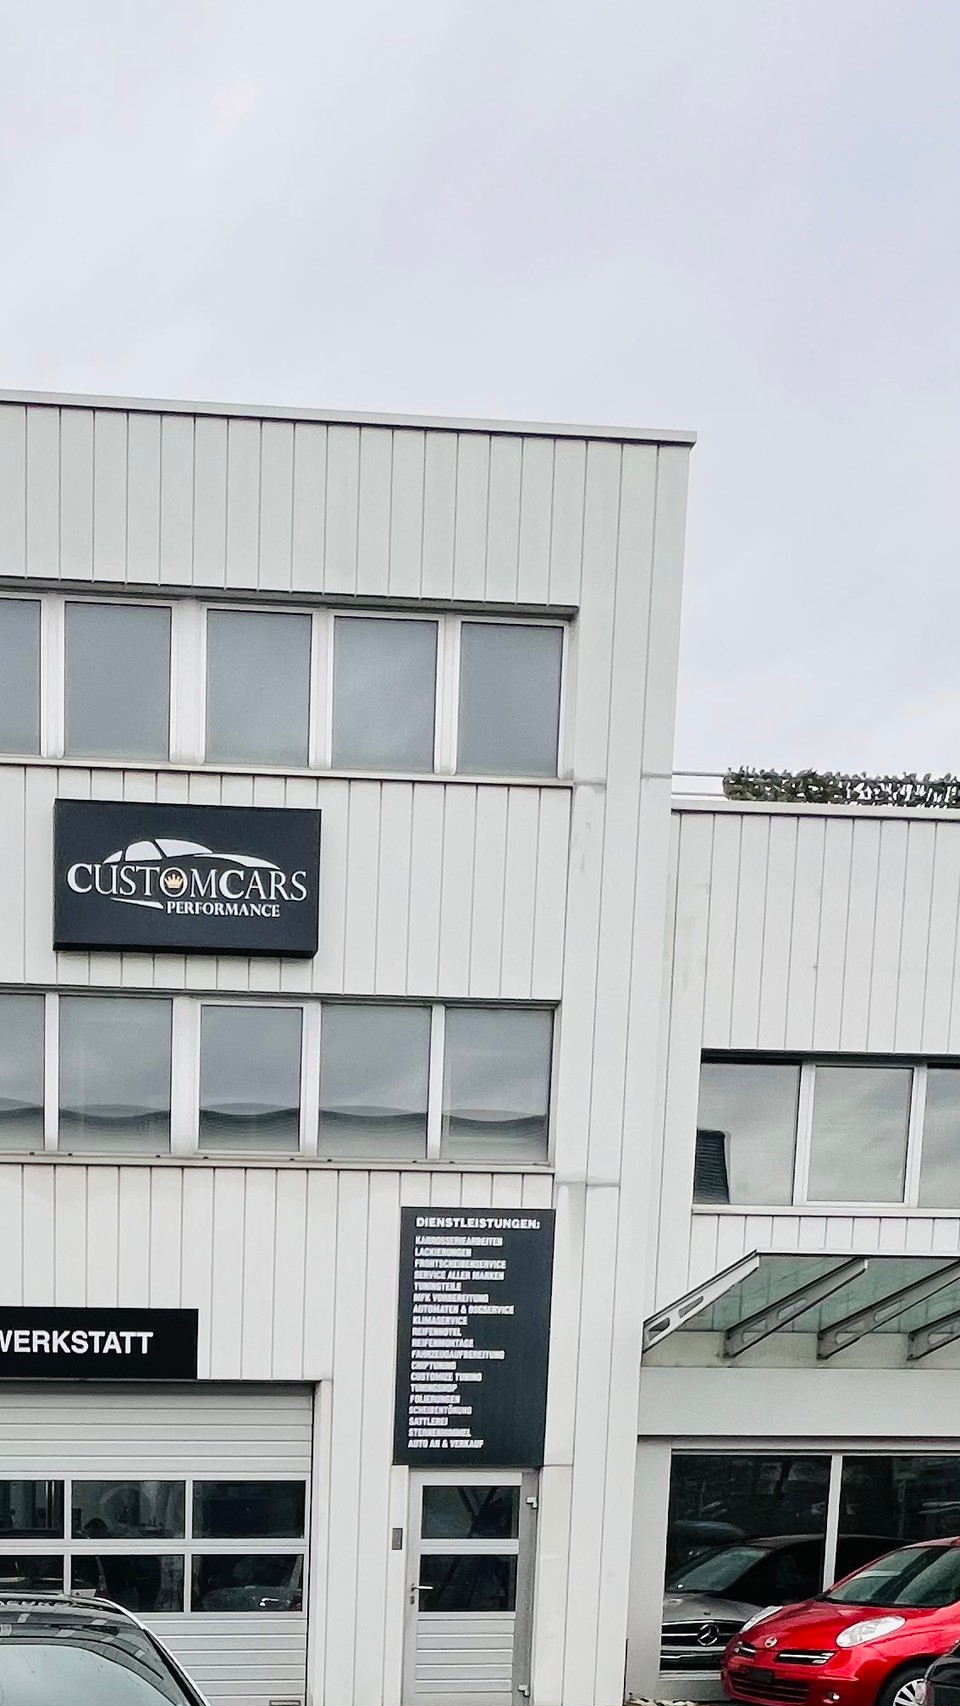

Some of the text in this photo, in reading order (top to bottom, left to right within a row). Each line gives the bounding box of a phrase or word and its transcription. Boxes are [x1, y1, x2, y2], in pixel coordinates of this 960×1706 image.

[66, 862, 308, 902] CUSTOMCARS
[166, 901, 280, 918] PERFORMANCE
[414, 1270, 446, 1279] SERVICE
[447, 1271, 470, 1280] ALLER
[461, 1305, 466, 1314] &
[408, 1439, 428, 1448] AUTO
